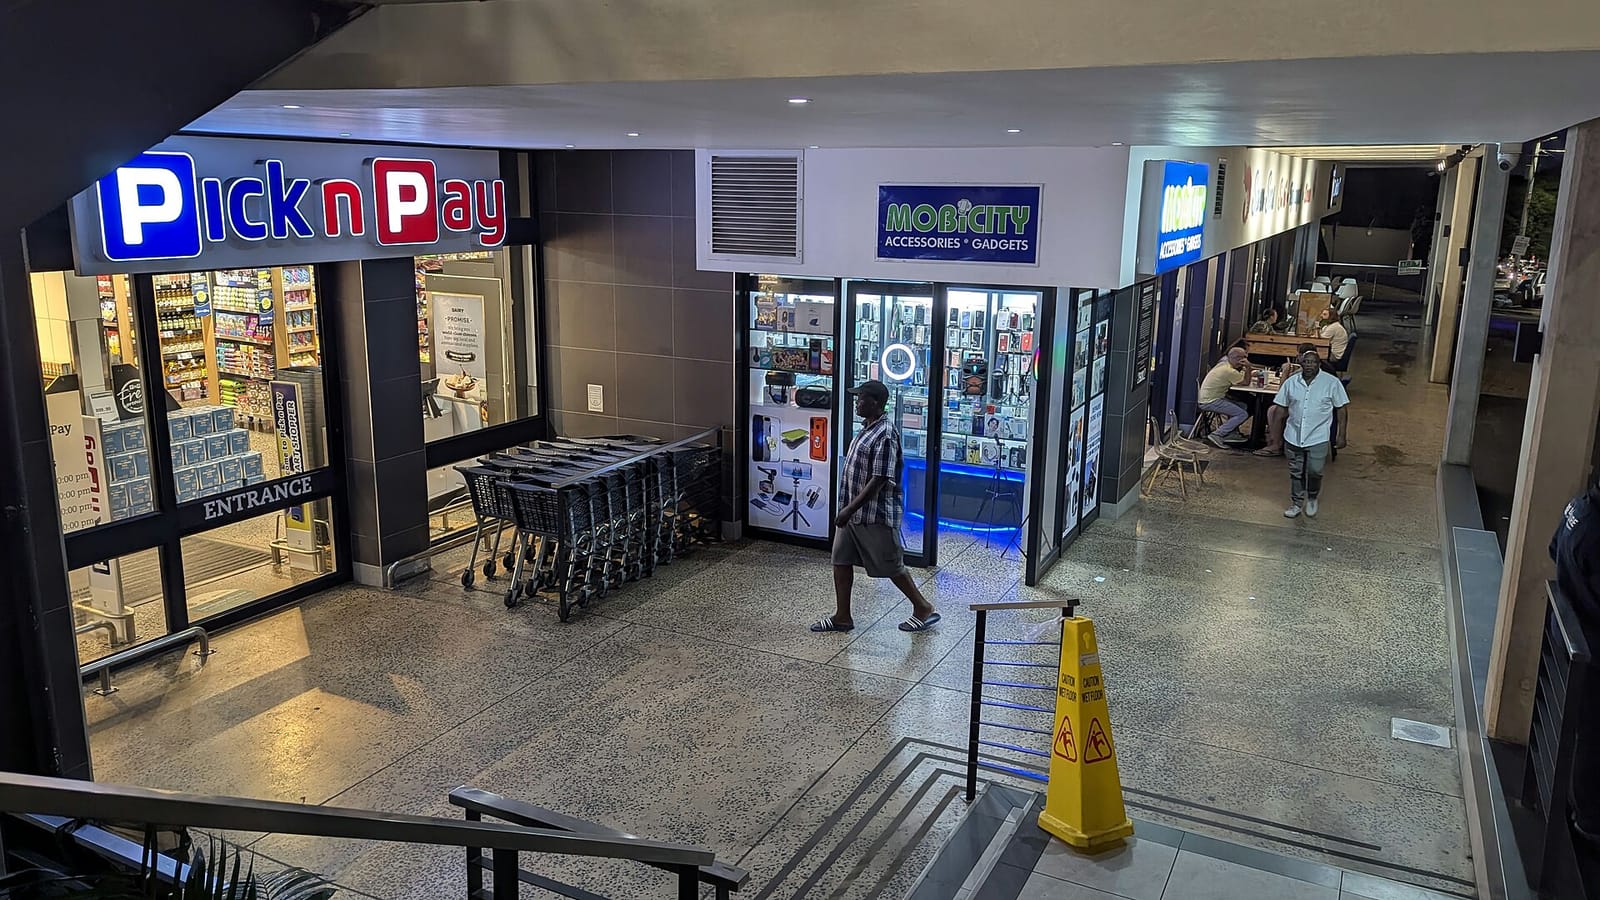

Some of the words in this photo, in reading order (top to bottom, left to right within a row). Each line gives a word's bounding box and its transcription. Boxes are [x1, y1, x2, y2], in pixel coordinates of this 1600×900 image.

[115, 160, 314, 246] Pick
[320, 178, 365, 237] n
[384, 171, 505, 247] Pay
[885, 236, 960, 249] ACCESSORIES
[972, 239, 1029, 250] GADGETS
[276, 392, 284, 410] Pay
[50, 424, 72, 436] Pay
[287, 401, 299, 449] SHOPPER
[282, 440, 287, 450] to
[76, 472, 89, 483] pm
[78, 487, 91, 498] pm
[203, 477, 312, 520] ENTRANCE
[79, 502, 93, 513] pm
[81, 517, 94, 529] pm
[1062, 673, 1075, 687] CAUTION
[1083, 675, 1099, 688] CAUTION
